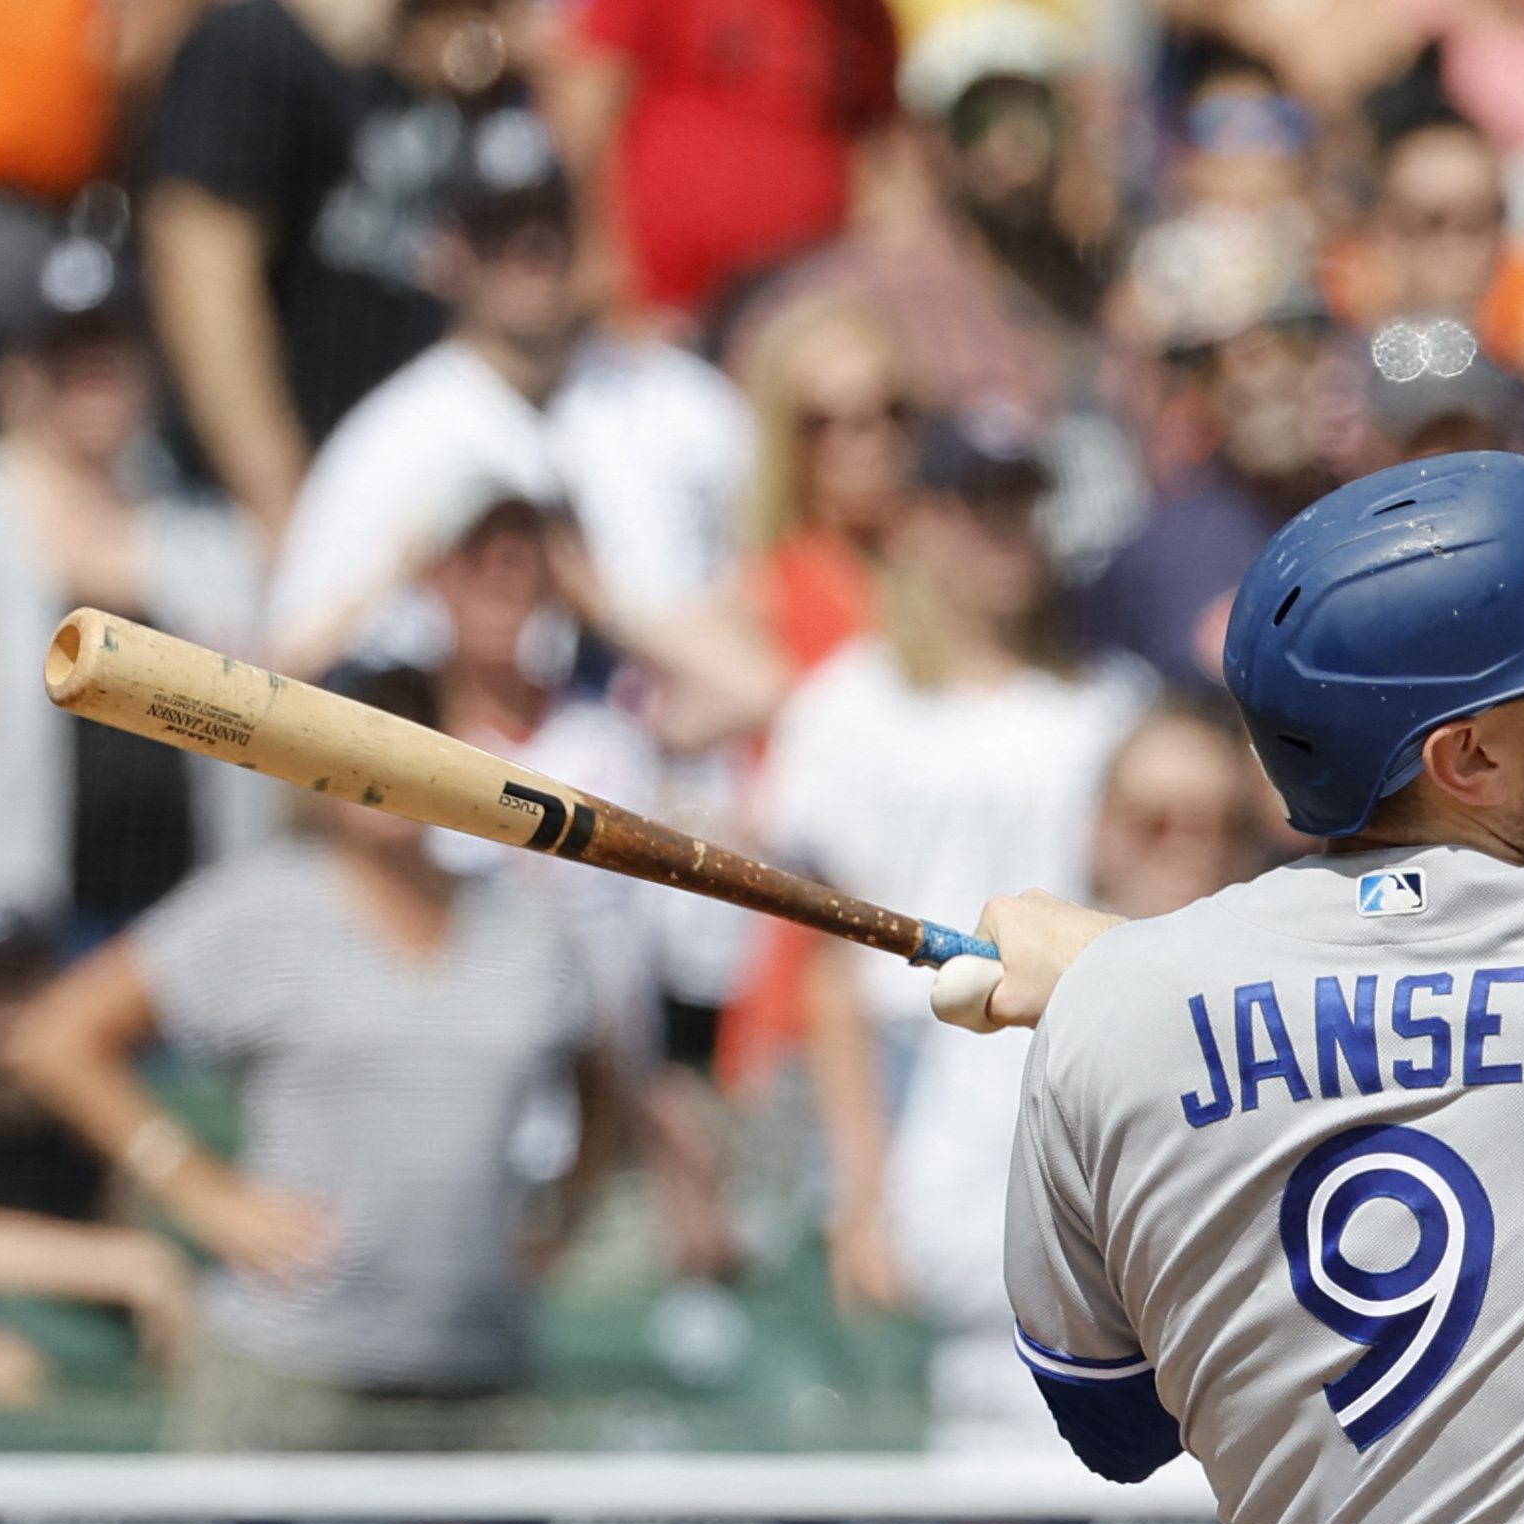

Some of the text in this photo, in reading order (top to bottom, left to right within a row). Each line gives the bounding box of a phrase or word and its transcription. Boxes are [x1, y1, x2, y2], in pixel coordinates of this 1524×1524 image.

[145, 702, 203, 729] JANSEN
[200, 721, 251, 746] DANNY
[499, 795, 538, 815] TUCCI
[1279, 1123, 1495, 1453] 9
